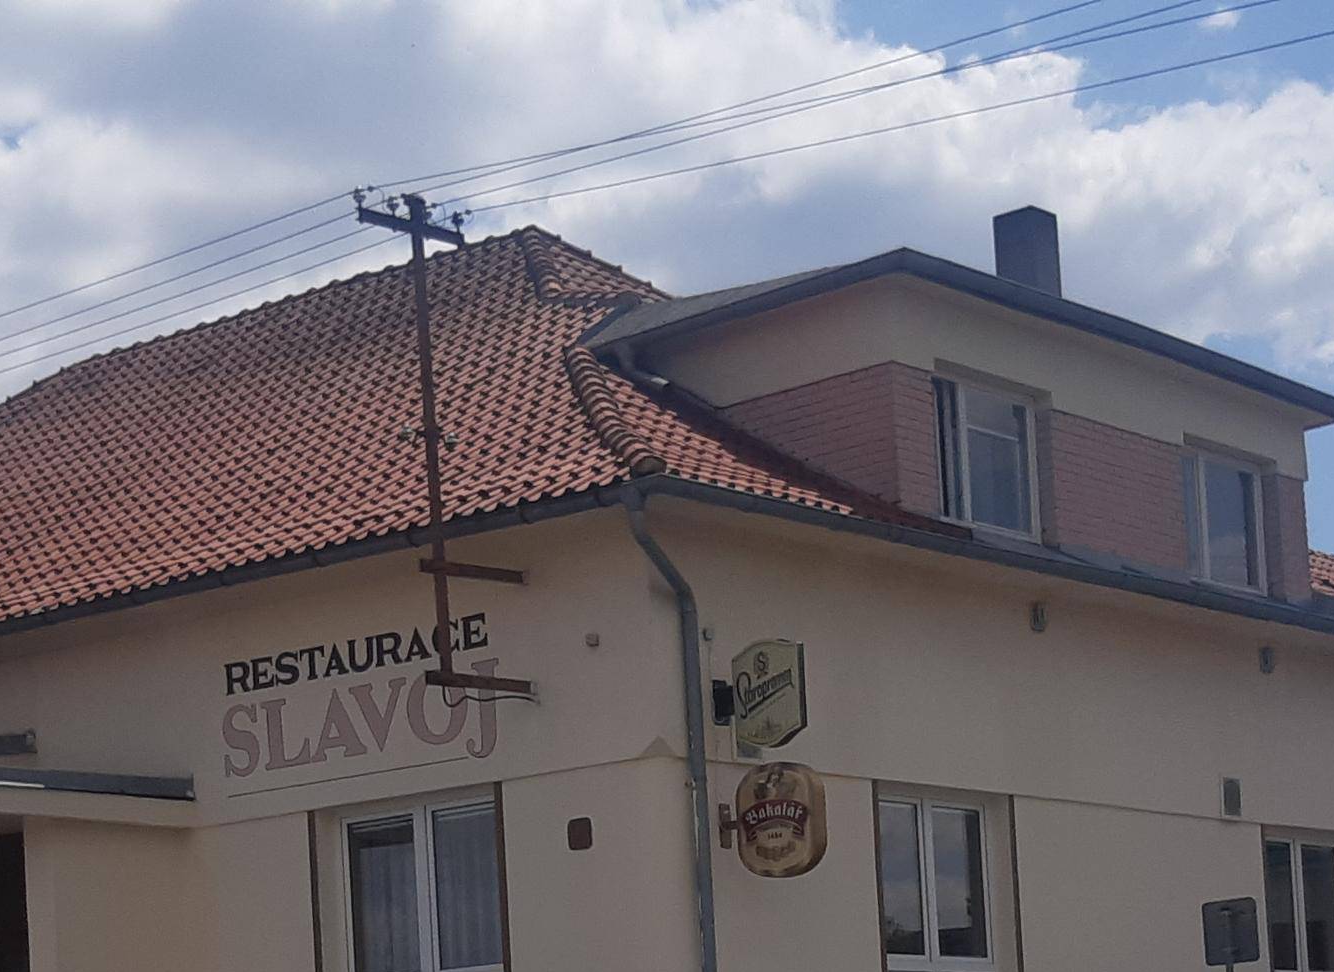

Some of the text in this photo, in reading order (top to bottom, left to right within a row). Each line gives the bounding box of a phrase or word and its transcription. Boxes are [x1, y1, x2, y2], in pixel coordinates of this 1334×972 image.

[223, 612, 489, 696] RESTAURACE
[221, 656, 500, 778] SLAVOJ
[745, 802, 804, 825] Bakalář
